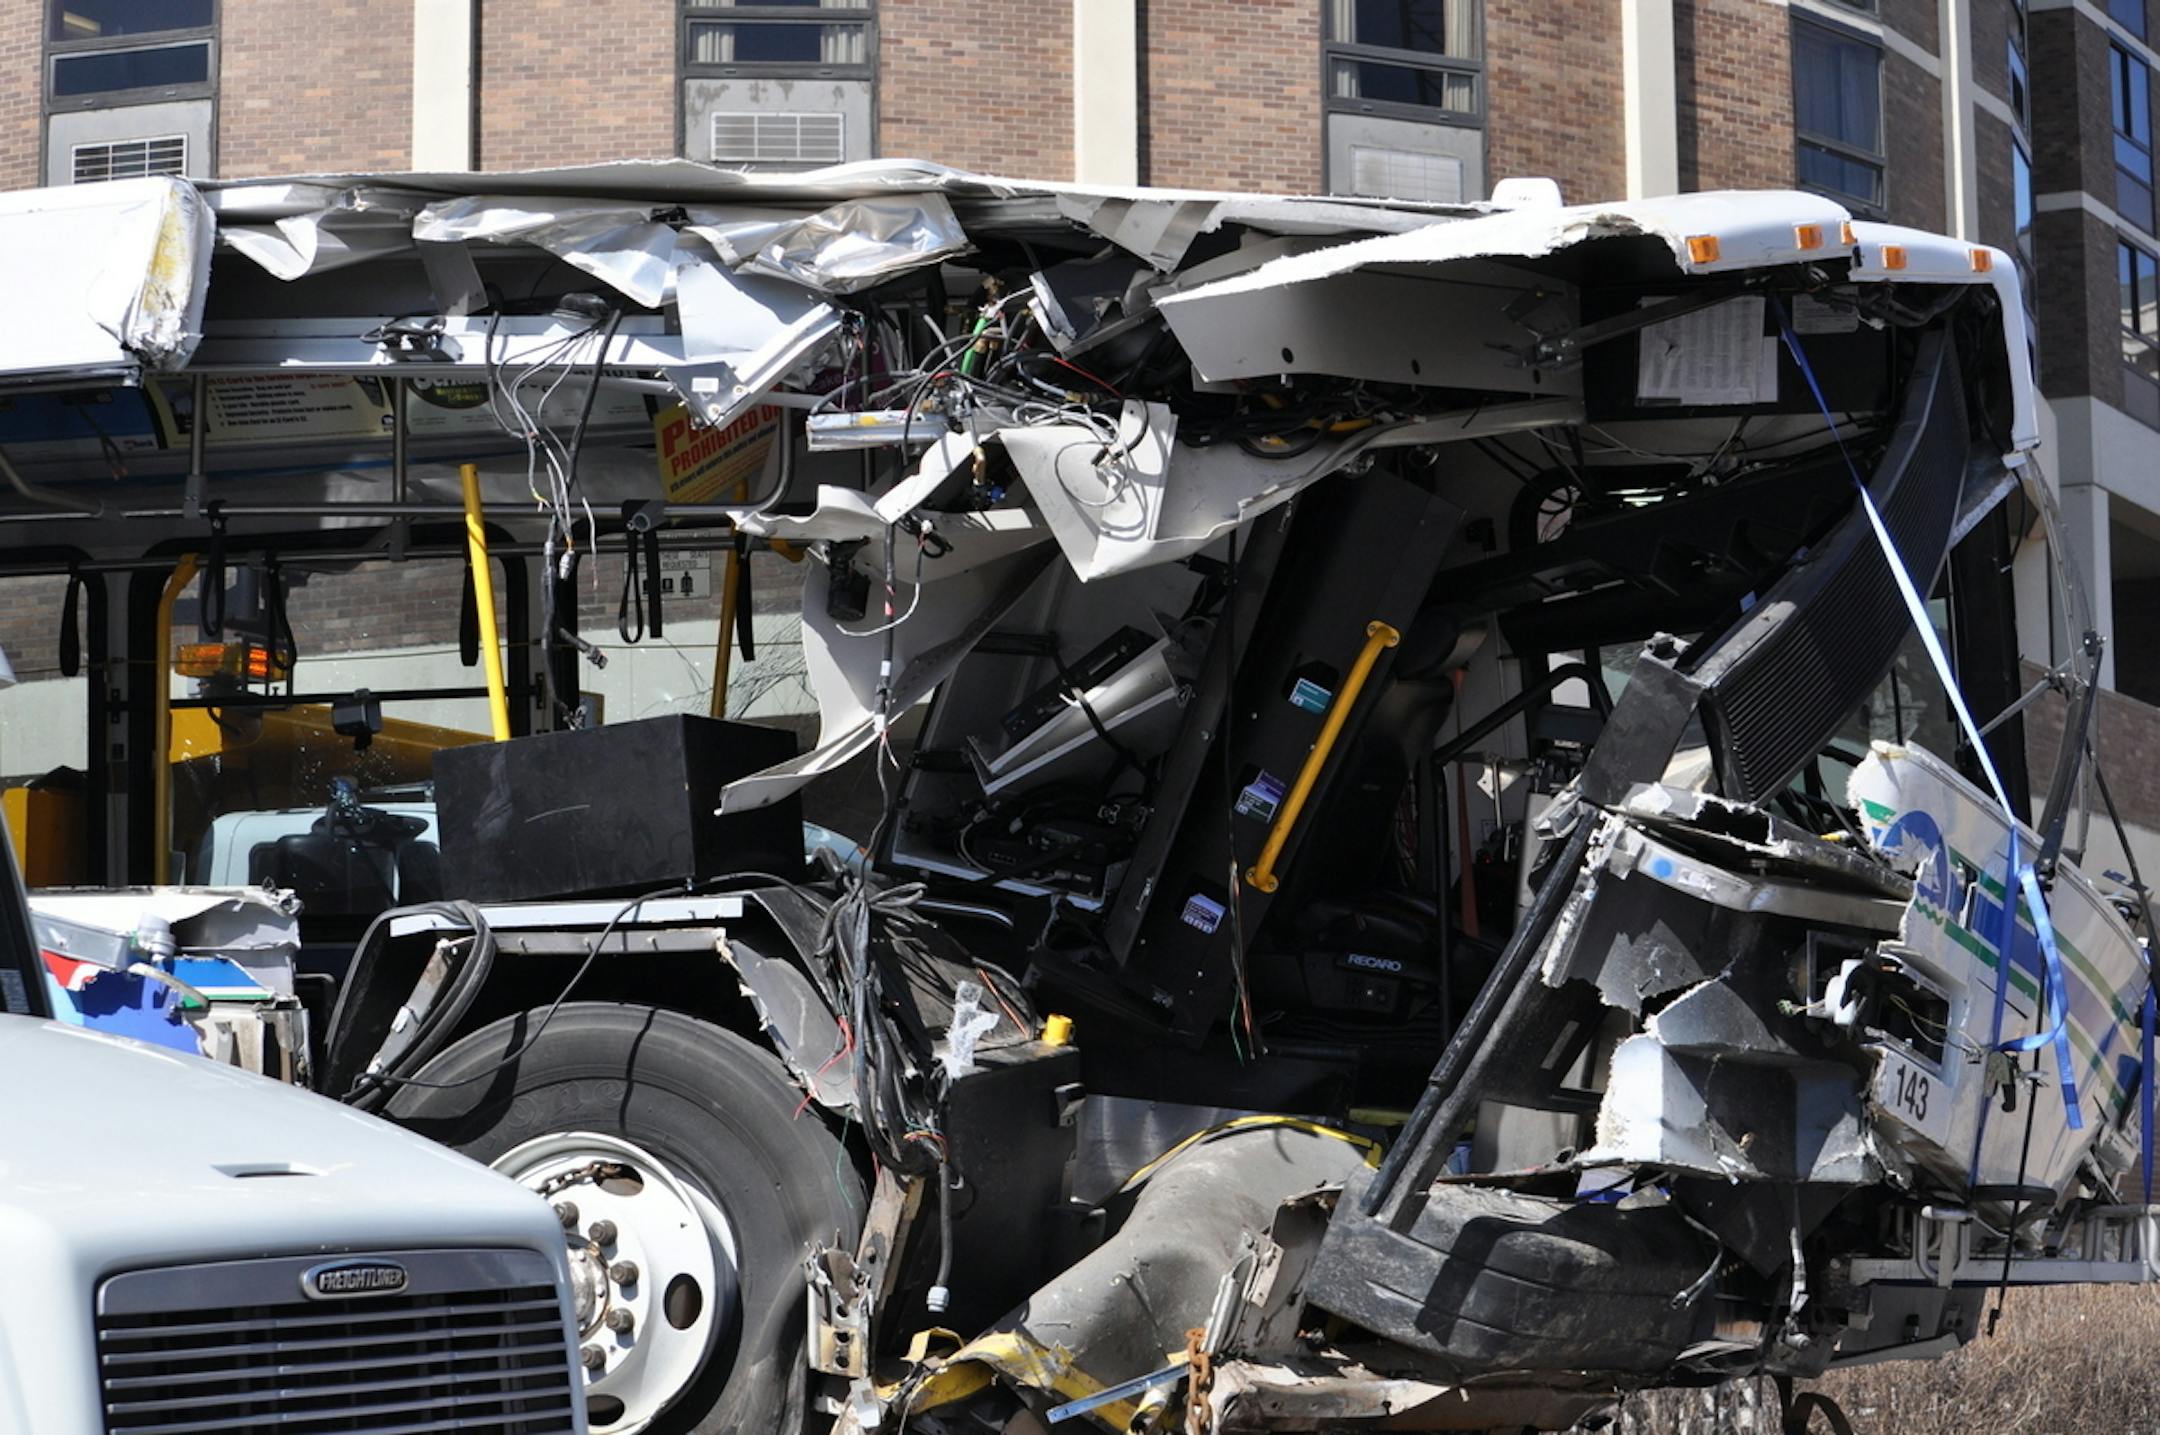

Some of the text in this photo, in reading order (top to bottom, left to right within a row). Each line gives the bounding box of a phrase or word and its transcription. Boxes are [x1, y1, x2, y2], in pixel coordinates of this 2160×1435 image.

[671, 409, 758, 477] PROHIBITED
[1348, 953, 1402, 972] RECARO
[1896, 1064, 1929, 1121] 143
[319, 1268, 403, 1291] FREIGHTLINER
